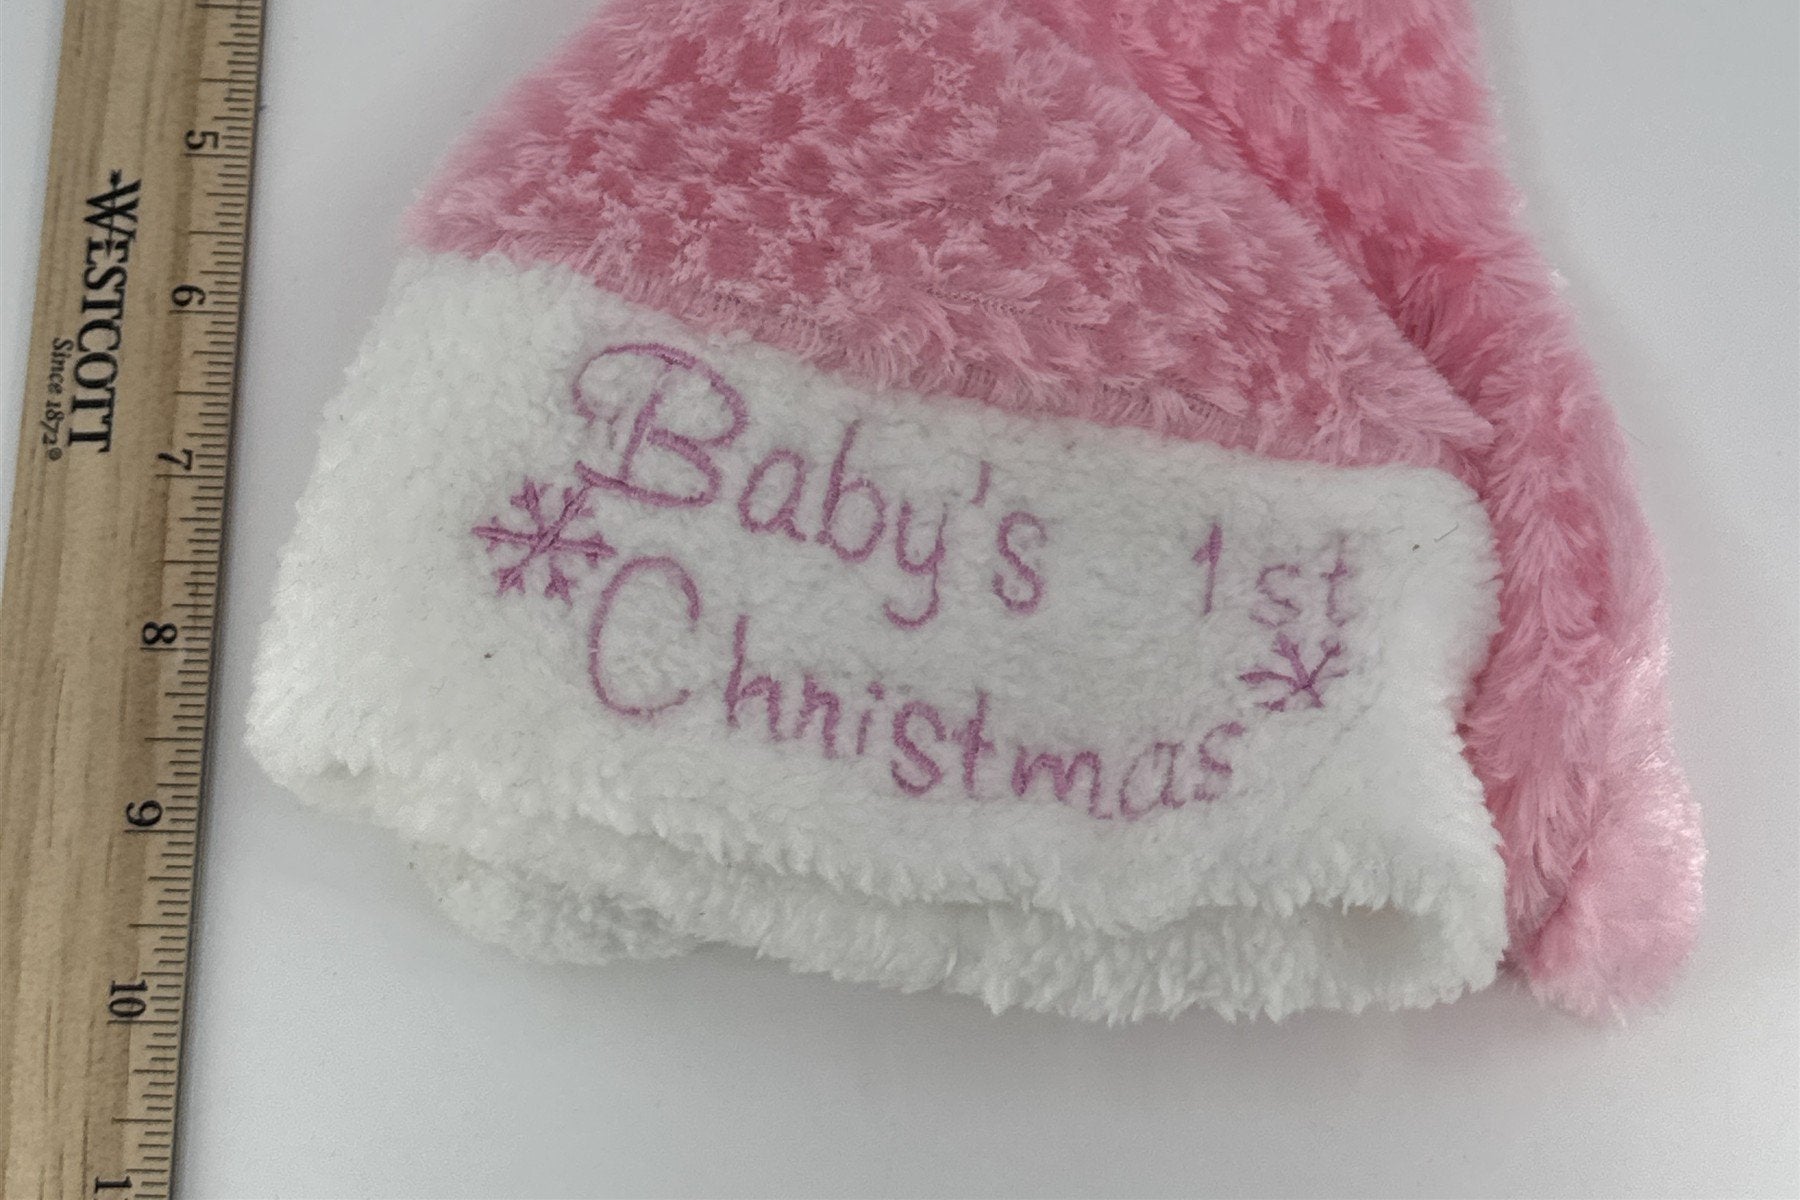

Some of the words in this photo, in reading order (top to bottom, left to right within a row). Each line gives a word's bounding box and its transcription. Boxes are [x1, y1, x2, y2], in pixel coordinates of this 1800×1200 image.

[183, 129, 220, 151] 5
[171, 284, 207, 308] 6
[67, 178, 142, 454] WESTCOTT
[47, 337, 75, 395] Since
[156, 448, 194, 471] 7
[571, 342, 1046, 628] Baby's
[1192, 520, 1357, 629] 1st
[142, 621, 178, 646] 8
[588, 555, 1248, 822] Christmas
[125, 799, 164, 828] 9
[107, 979, 149, 1019] 10
